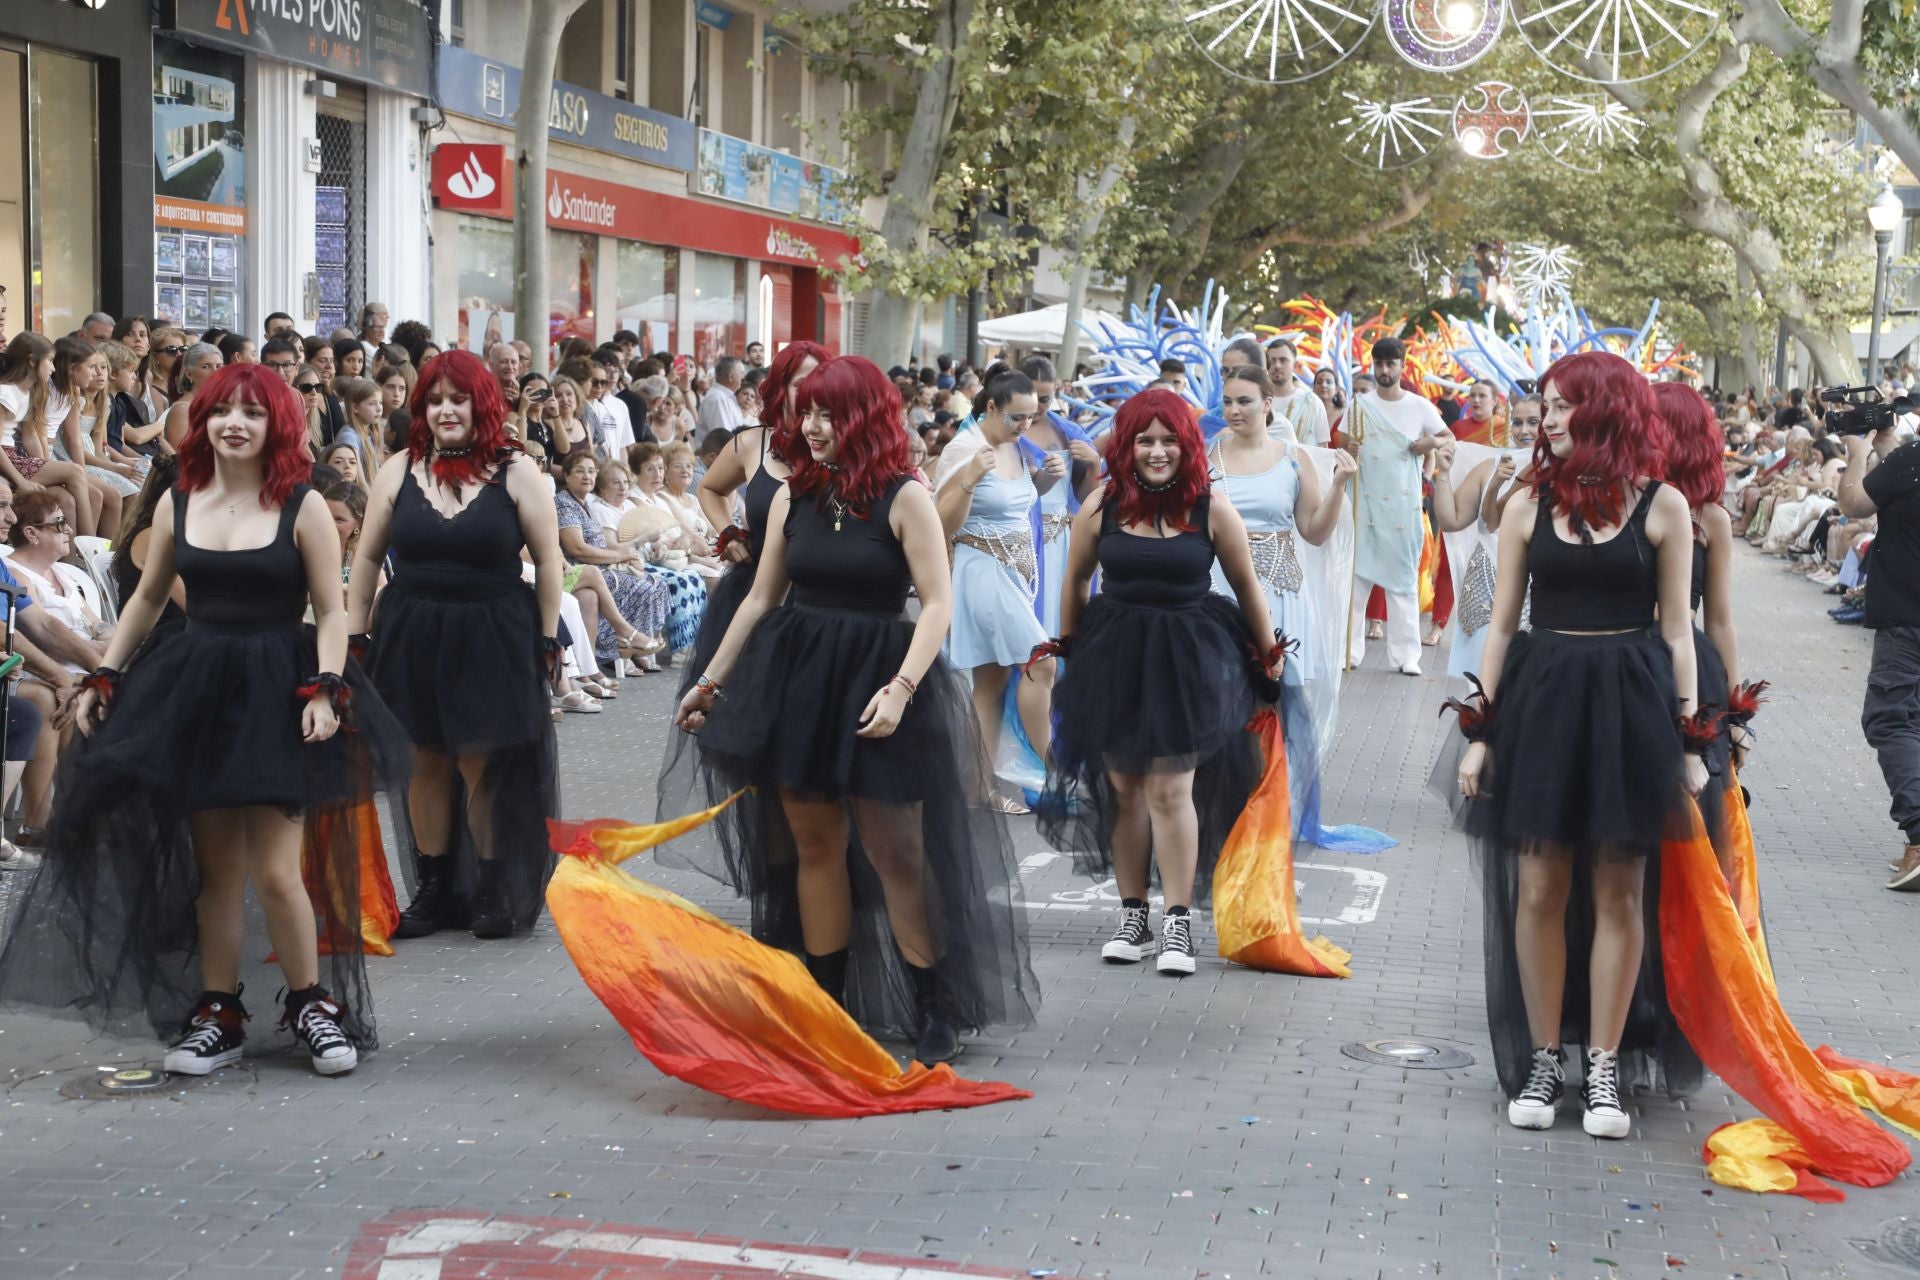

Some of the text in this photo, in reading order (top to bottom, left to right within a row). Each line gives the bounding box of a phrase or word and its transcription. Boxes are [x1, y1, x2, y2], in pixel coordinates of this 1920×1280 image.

[310, 0, 361, 42] PONS
[308, 34, 361, 67] HOMES
[548, 88, 588, 136] ASO
[614, 112, 668, 152] SEGUROS
[161, 204, 200, 221] ARQUITECTURA
[563, 188, 617, 228] Santander
